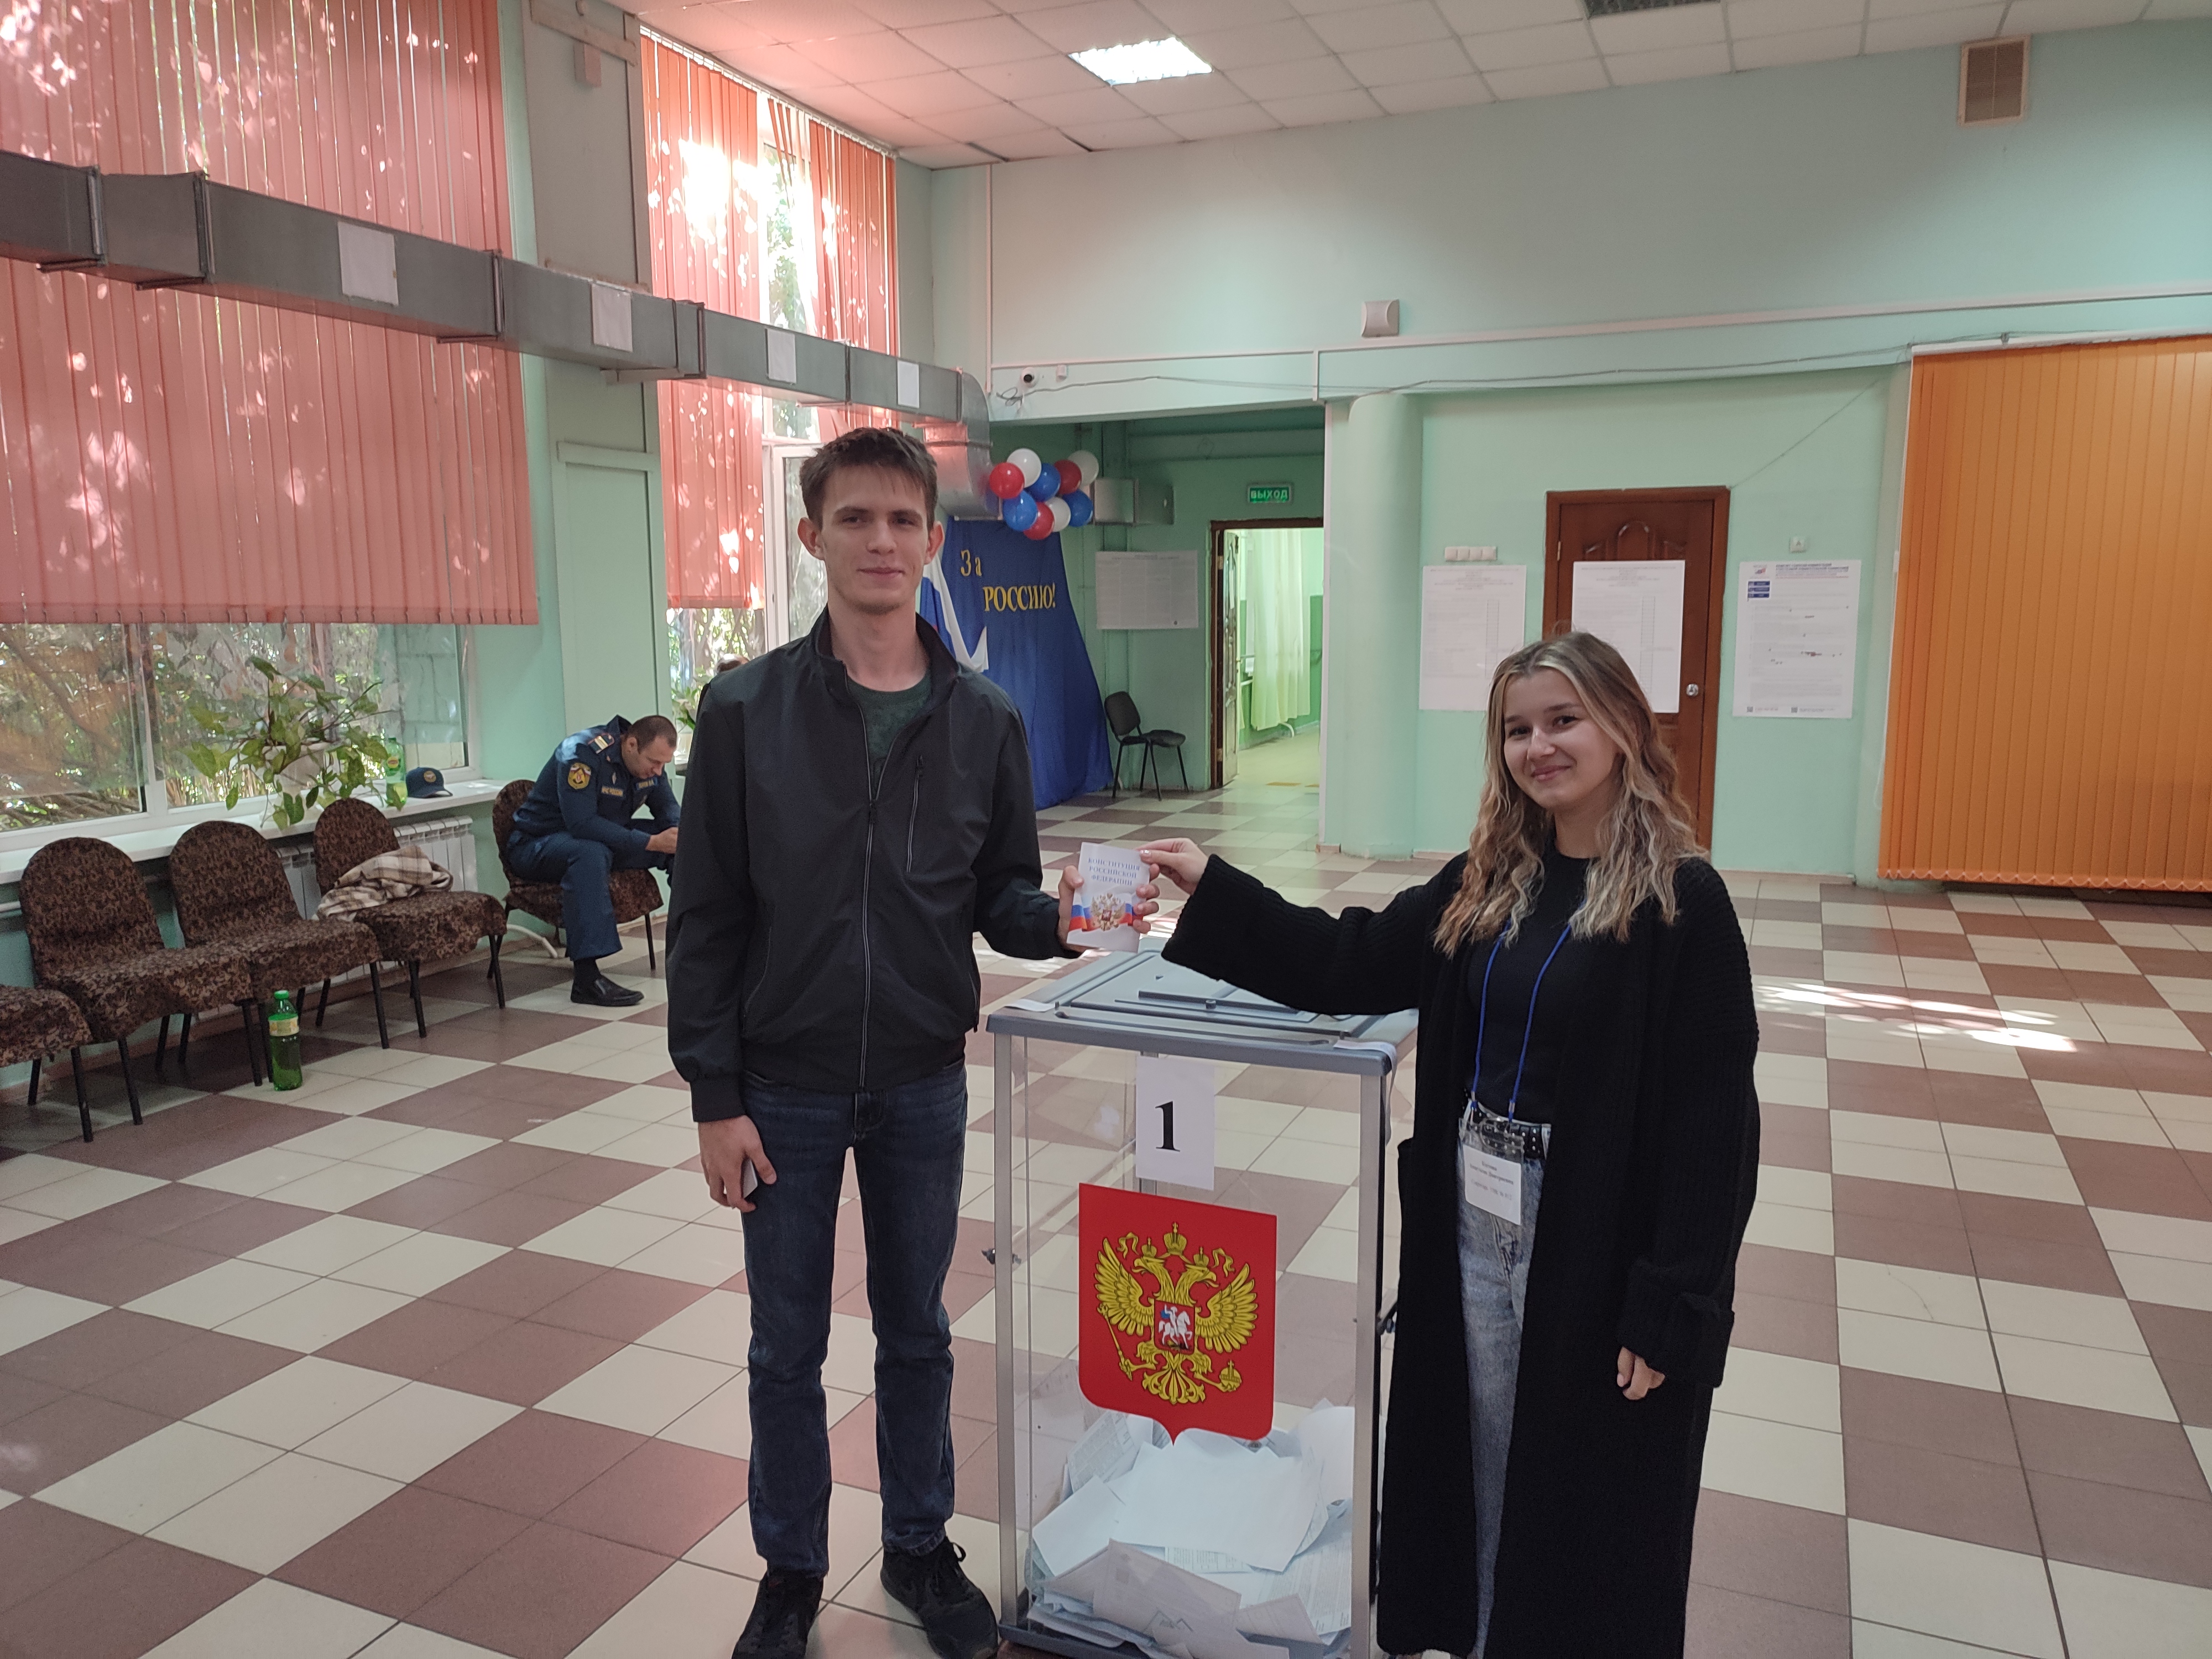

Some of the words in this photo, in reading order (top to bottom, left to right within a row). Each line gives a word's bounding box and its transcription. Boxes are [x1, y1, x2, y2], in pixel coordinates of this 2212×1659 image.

[1250, 489, 1288, 500] ВЫХОД
[982, 582, 1056, 612] РОССИЮ!
[1088, 858, 1140, 870] КОНСТИТУЦИЯ
[1089, 866, 1136, 878] РОССИЙСКОЙ
[1091, 874, 1132, 886] ФЕДЕРАЦИИ
[1155, 1100, 1181, 1152] 1
